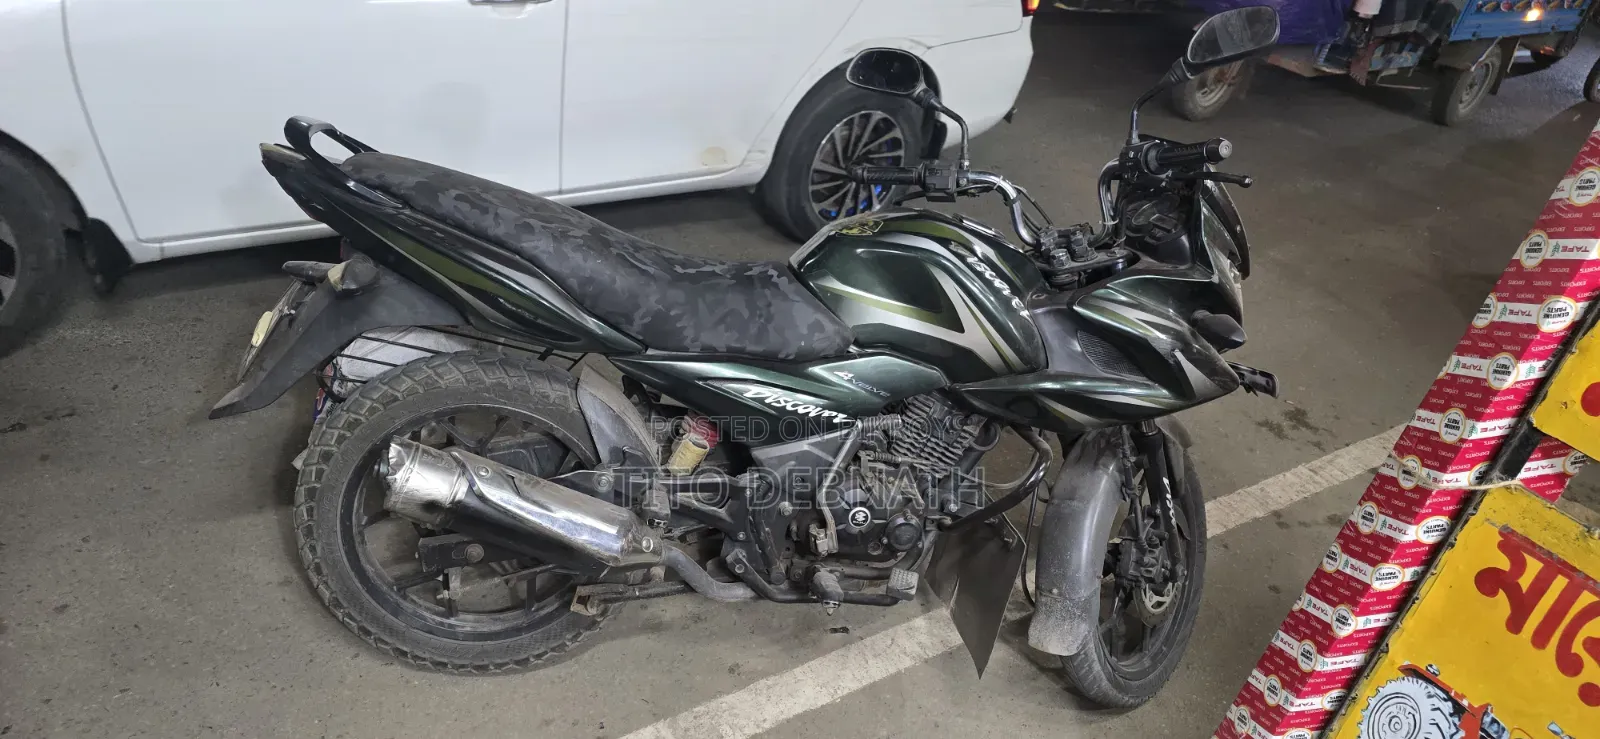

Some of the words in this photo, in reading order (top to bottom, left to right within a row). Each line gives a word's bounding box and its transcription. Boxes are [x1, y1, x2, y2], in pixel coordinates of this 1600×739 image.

[1560, 245, 1589, 253] TAFE
[1508, 308, 1532, 317] TAFE
[1460, 362, 1483, 372] TAFE
[744, 387, 856, 423] Discover
[1416, 415, 1436, 425] TAFE
[1381, 462, 1395, 470] TAF
[1523, 463, 1557, 473] TAFE
[1386, 522, 1409, 536] TAFE
[1349, 562, 1368, 576] TAFE
[1311, 602, 1329, 616] TAFE
[1279, 637, 1295, 650] TAFE
